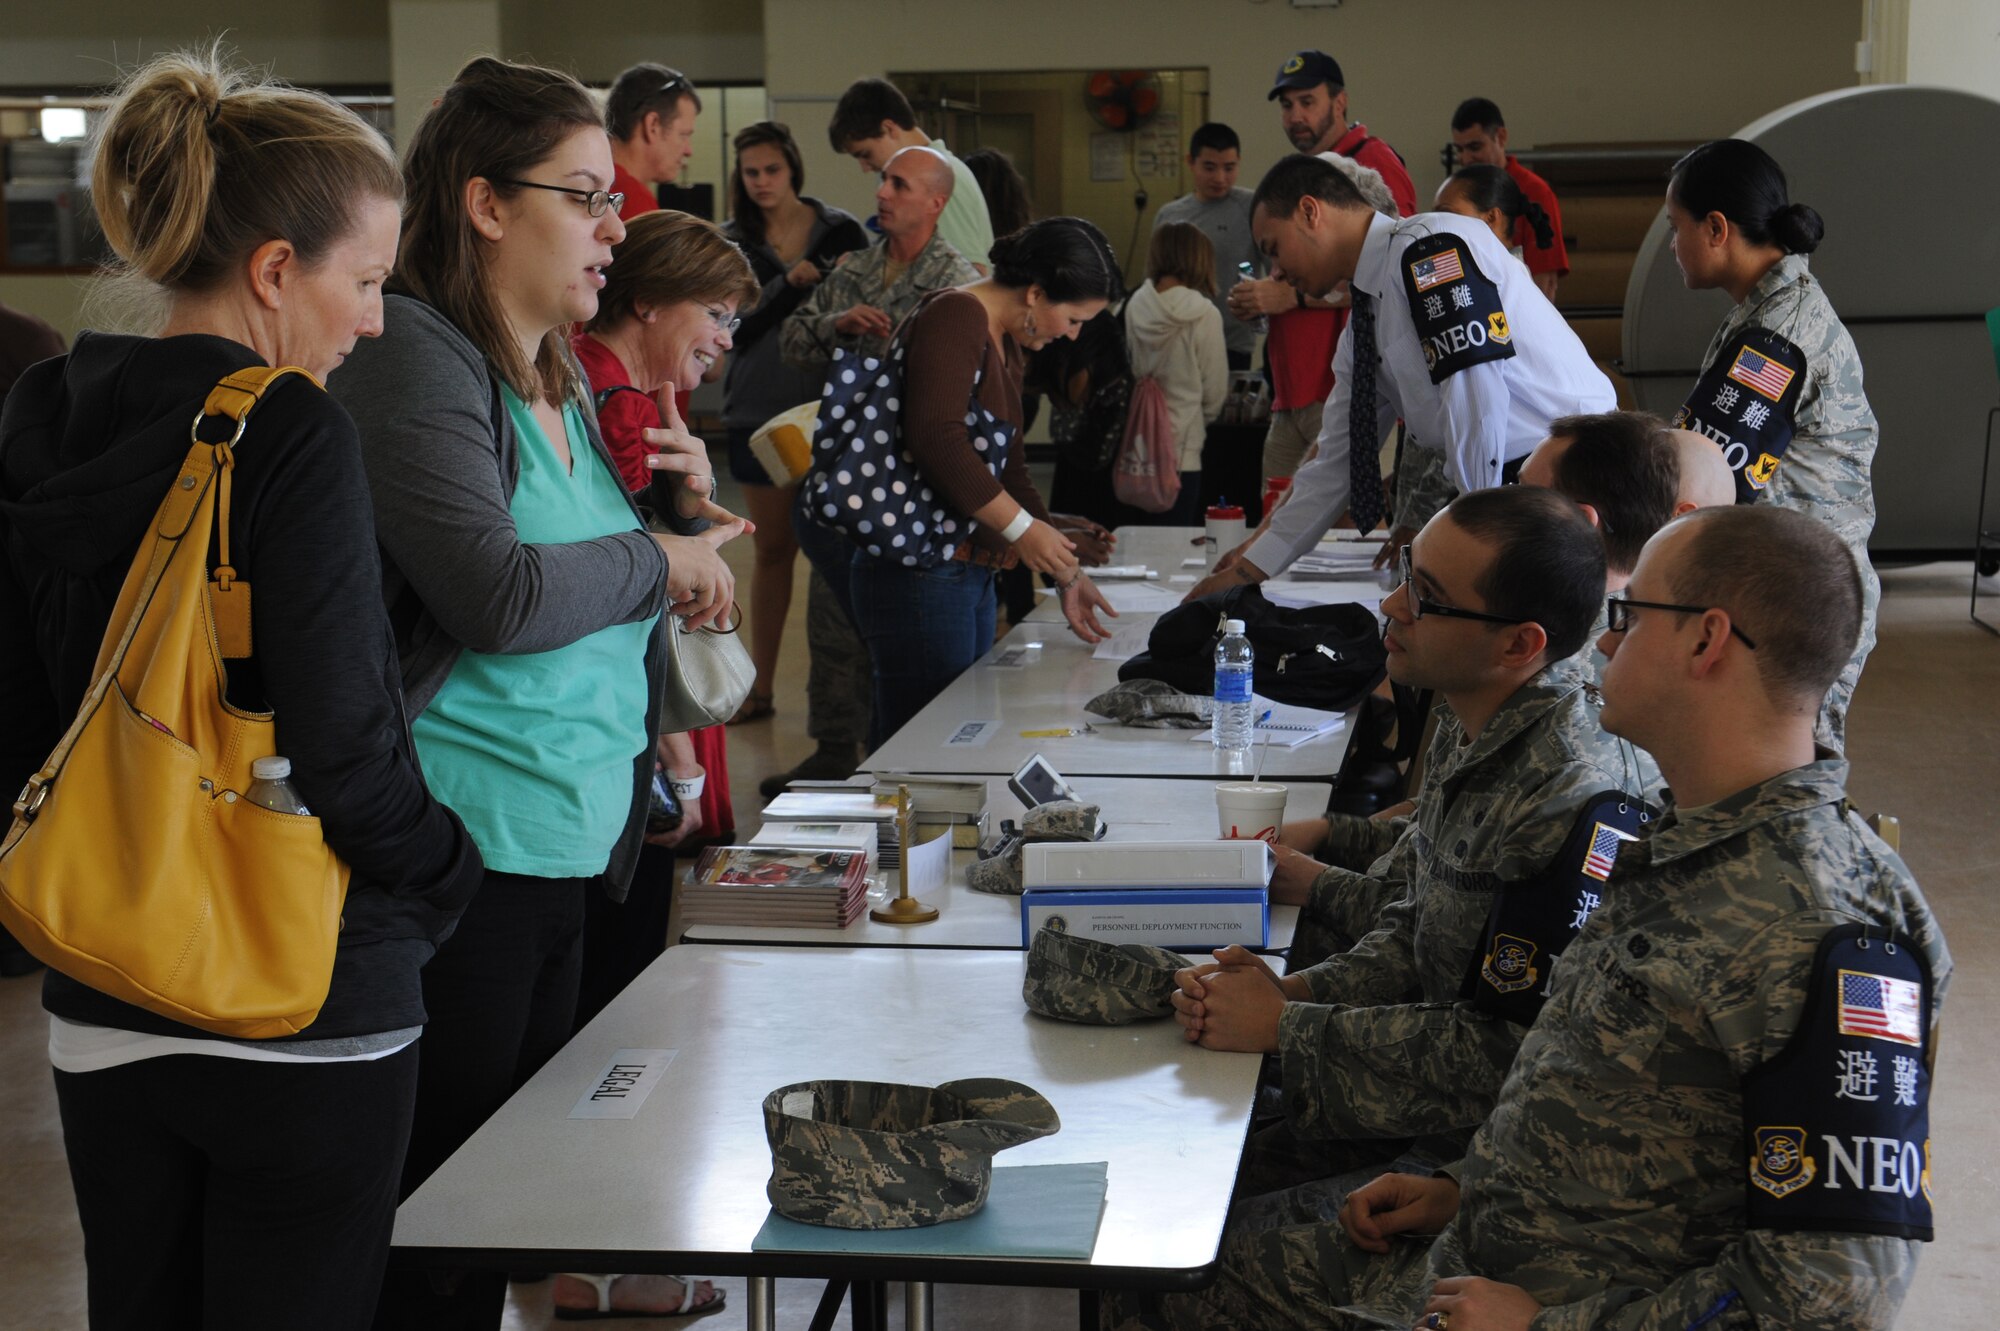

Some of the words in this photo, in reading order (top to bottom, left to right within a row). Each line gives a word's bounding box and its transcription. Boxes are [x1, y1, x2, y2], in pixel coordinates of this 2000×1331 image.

[1423, 284, 1475, 321] 避難
[1431, 320, 1487, 360] NEO
[1711, 382, 1771, 432] 避難
[1092, 923, 1140, 931] PERSONNEL
[1141, 922, 1198, 931] DEPLOYMENT
[1199, 922, 1242, 930] FUNCTION
[590, 1064, 648, 1101] LEGAL
[1834, 1049, 1919, 1107] 避難
[1821, 1134, 1921, 1199] NEO
